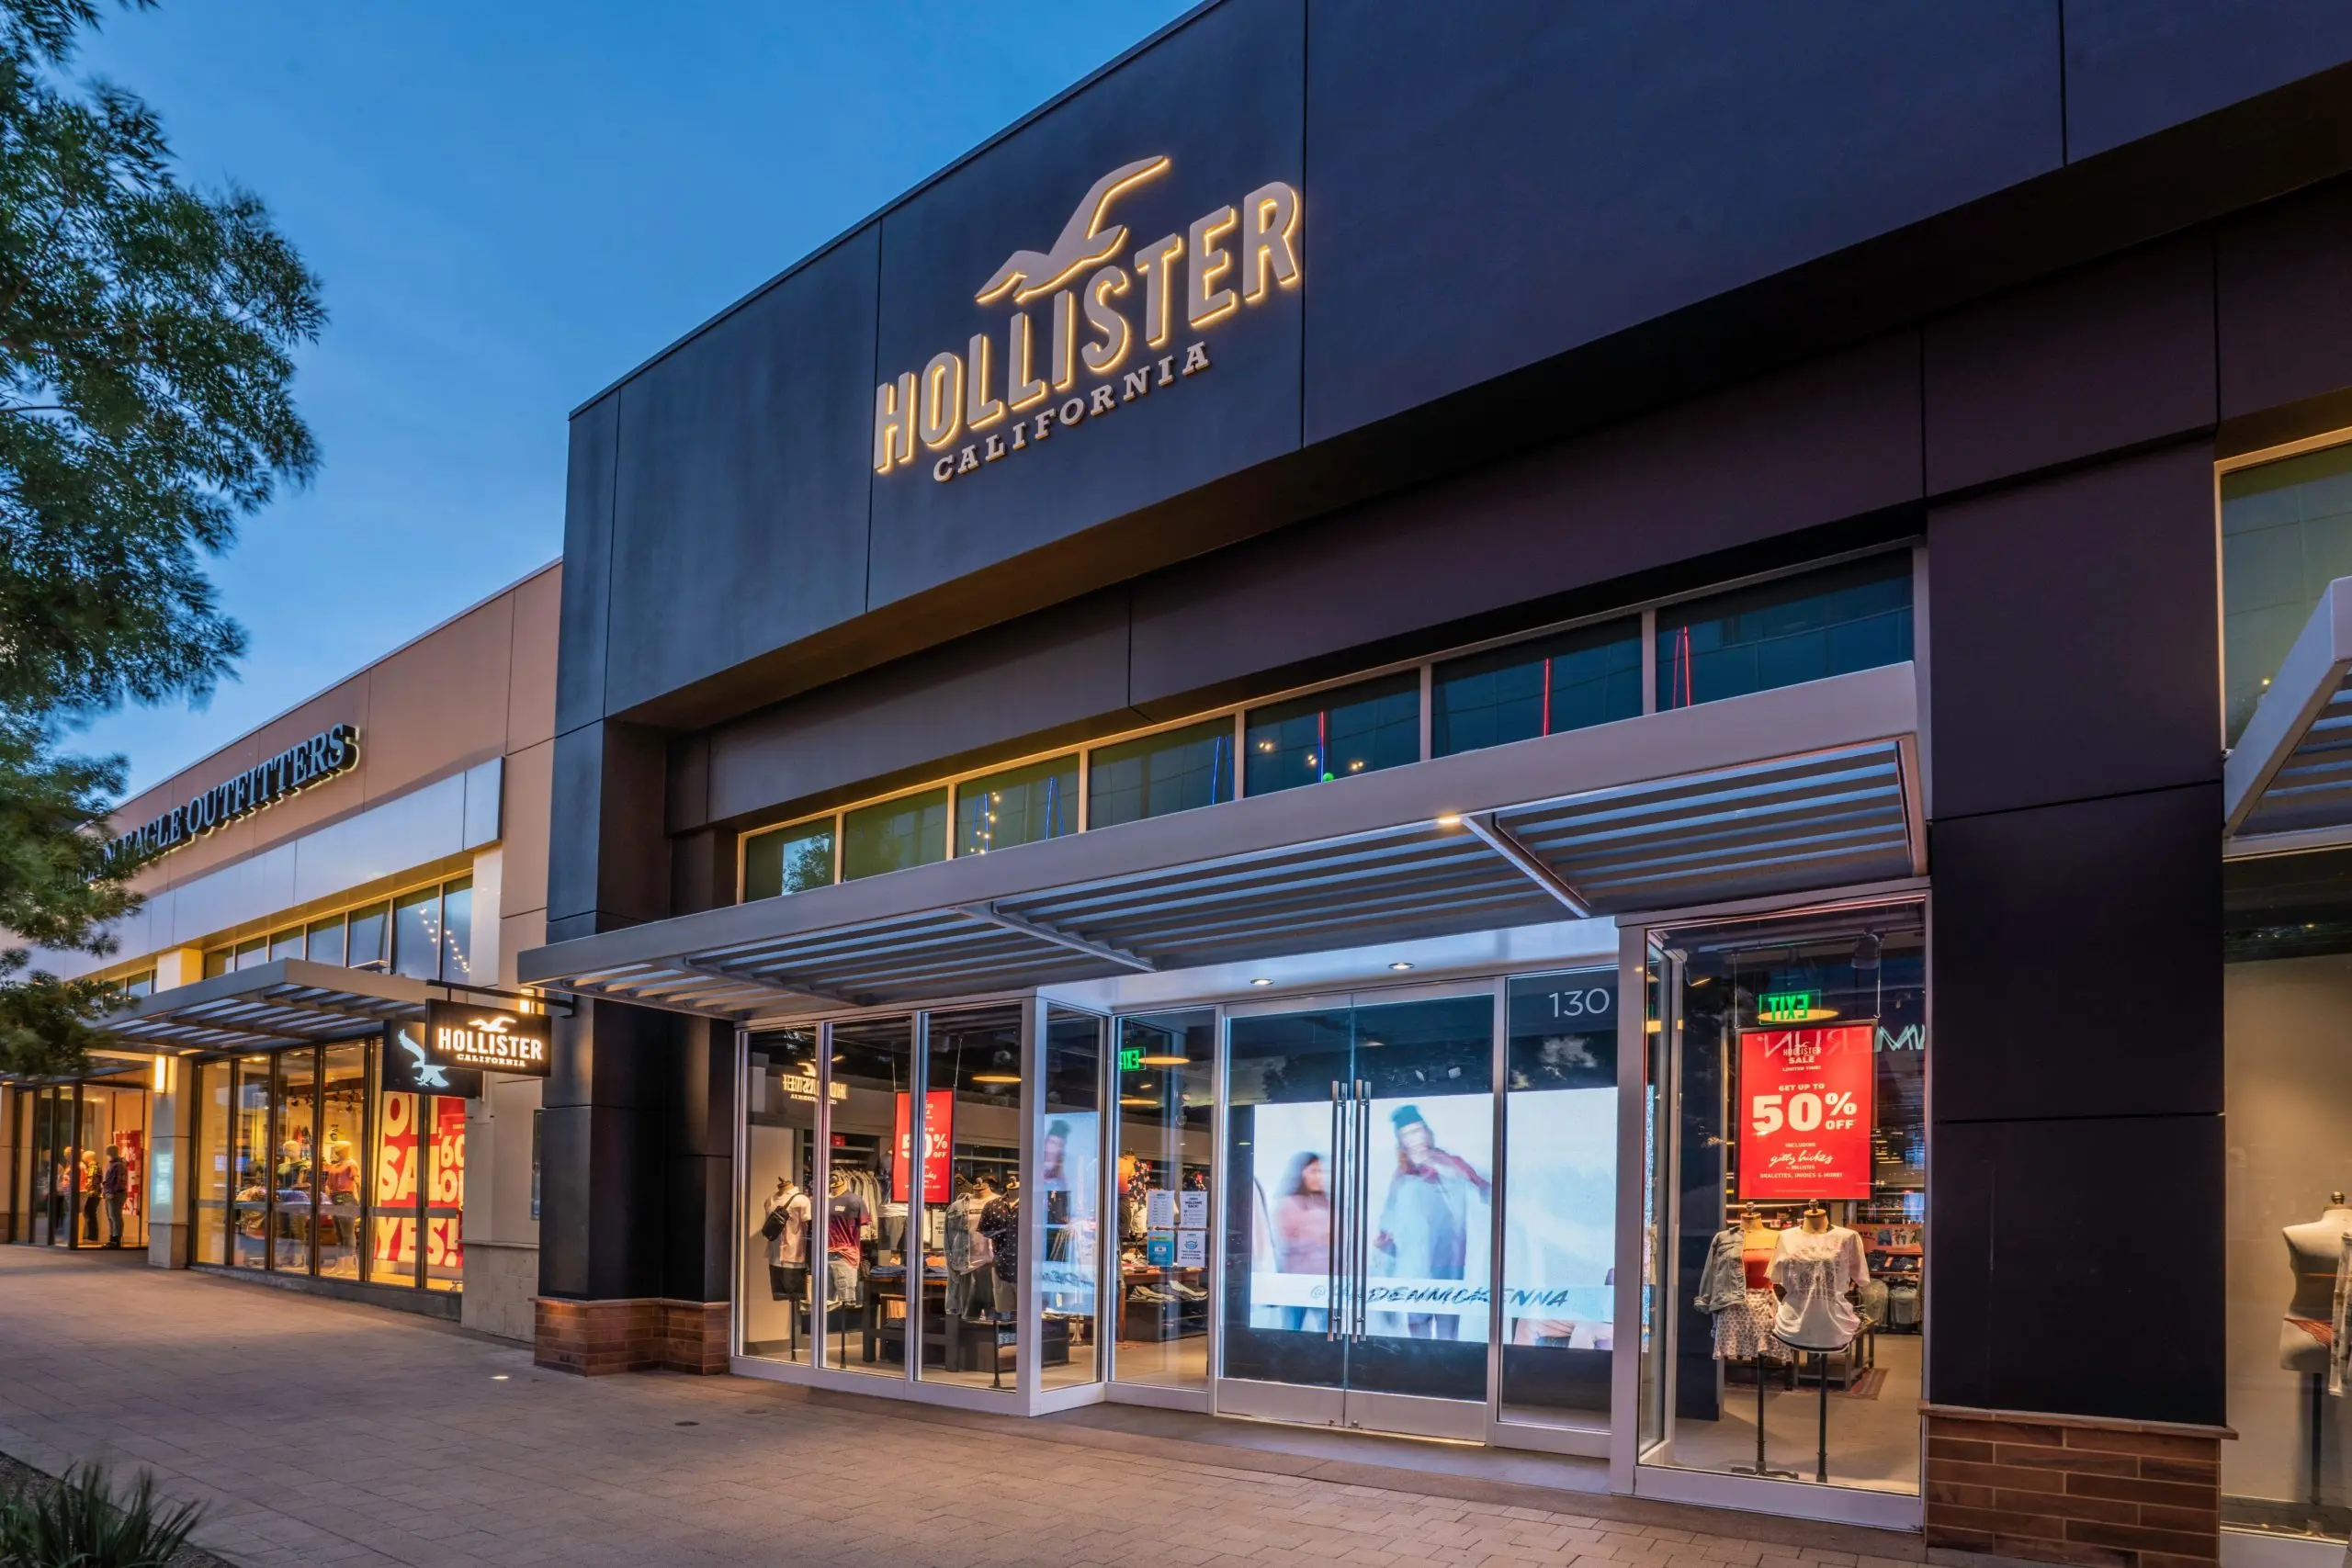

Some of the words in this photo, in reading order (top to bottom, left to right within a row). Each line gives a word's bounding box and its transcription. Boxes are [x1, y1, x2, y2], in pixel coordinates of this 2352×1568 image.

[874, 181, 1299, 474] HOLLISTER
[933, 340, 1209, 482] CALIFORNIA
[121, 806, 186, 862] EAGLE
[186, 722, 359, 834] OUTFITTERS
[1549, 987, 1610, 1018] 130
[437, 1027, 543, 1060] HOLLISTER
[1782, 1046, 1822, 1056] HOLLISTER
[457, 1053, 526, 1067] CALIFORNIA
[1789, 1055, 1815, 1065] SALE
[1752, 1091, 1858, 1132] 50%
[1825, 1119, 1855, 1130] OFF
